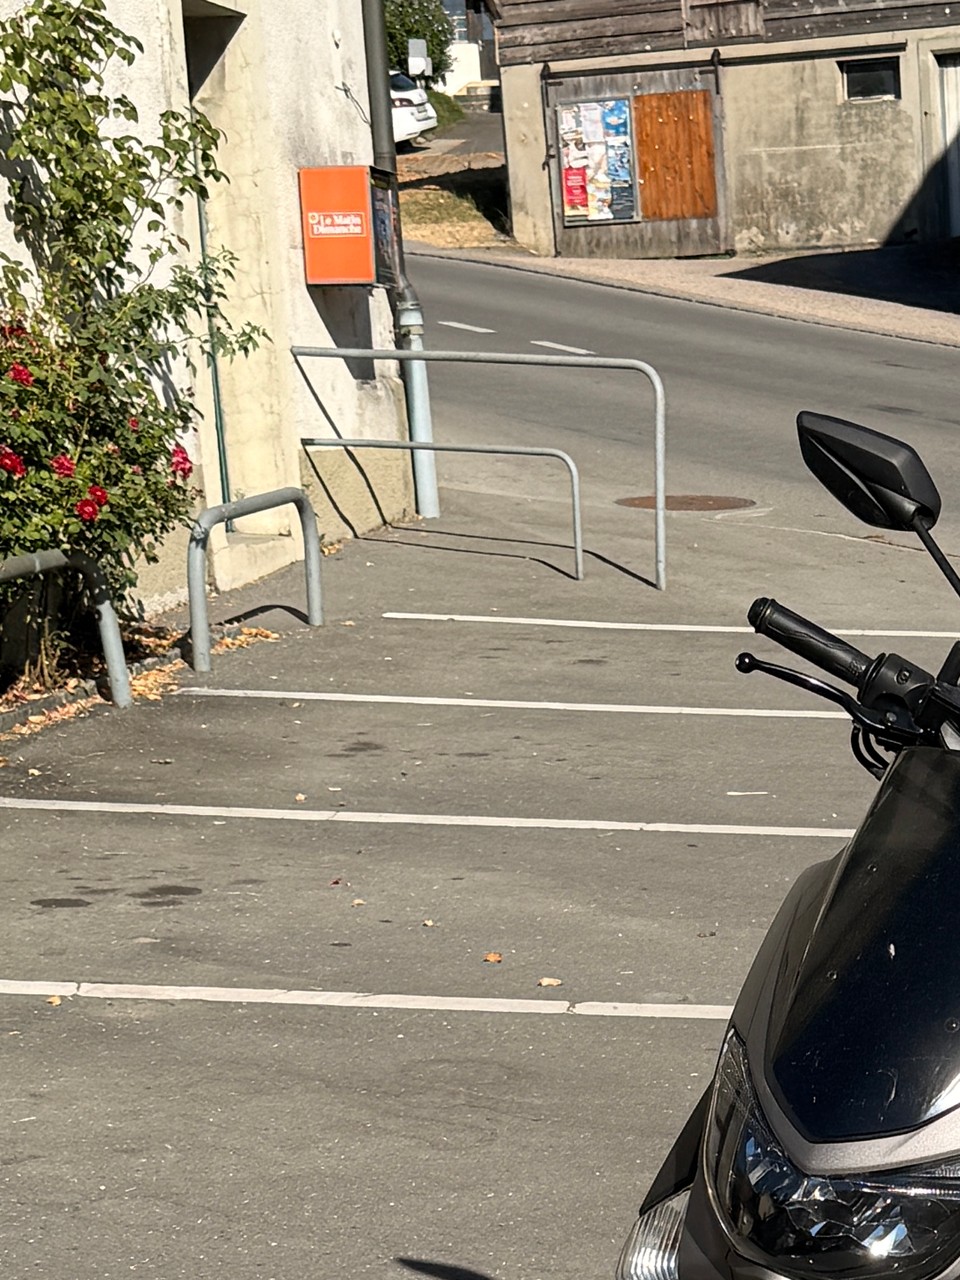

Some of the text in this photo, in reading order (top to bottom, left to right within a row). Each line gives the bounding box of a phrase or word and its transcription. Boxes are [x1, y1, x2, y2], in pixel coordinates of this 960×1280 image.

[320, 214, 362, 226] Le Matin
[313, 224, 362, 235] Dimanche
